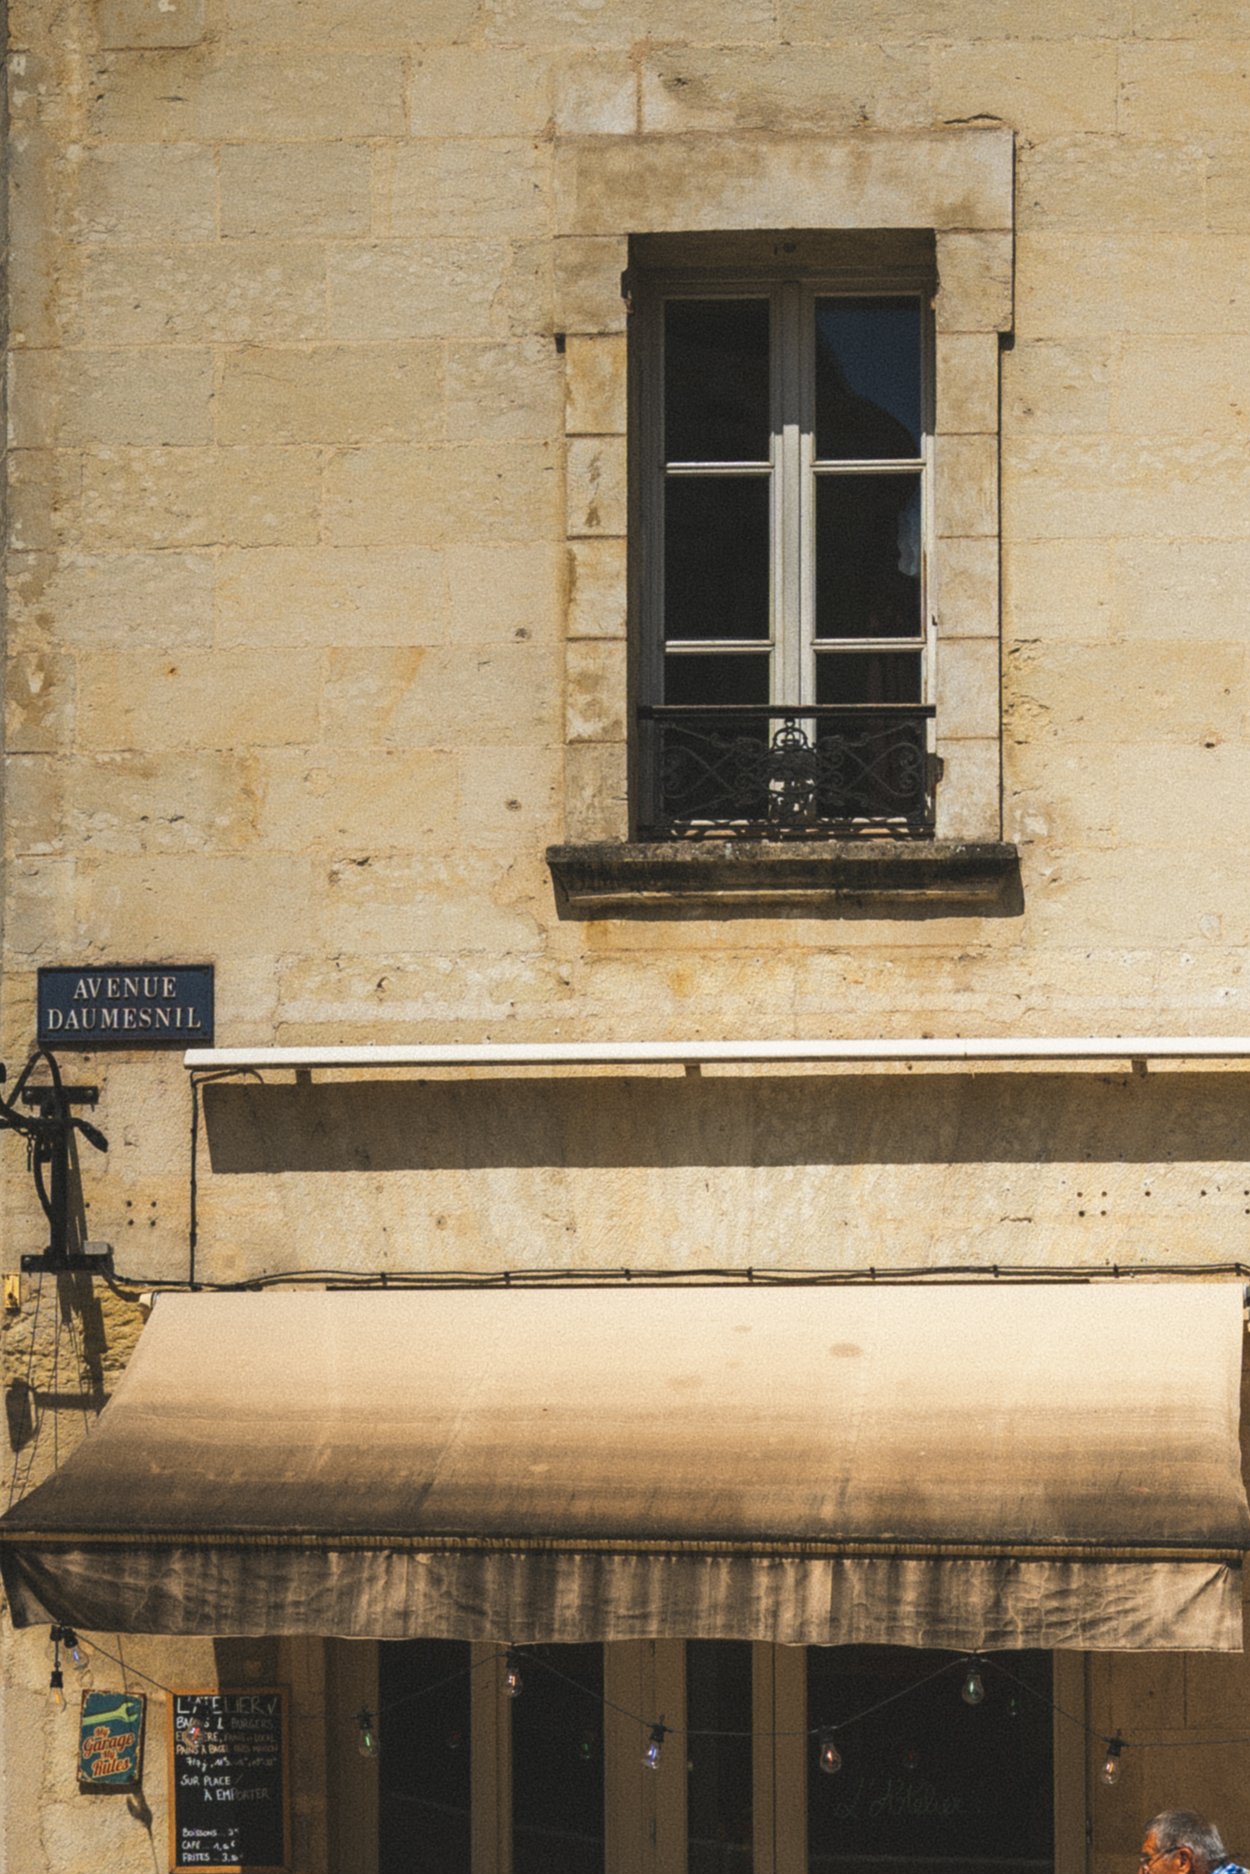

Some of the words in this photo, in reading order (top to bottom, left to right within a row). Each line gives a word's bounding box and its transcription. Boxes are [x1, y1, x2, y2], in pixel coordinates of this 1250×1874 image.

[73, 976, 177, 999] AVENUE
[47, 1007, 202, 1030] DAUMESNIL
[83, 1733, 135, 1759] Garage
[92, 1758, 131, 1778] Rules
[180, 1774, 200, 1786] SUR
[203, 1775, 231, 1787] PLACE
[216, 1788, 270, 1802] EMPORTER
